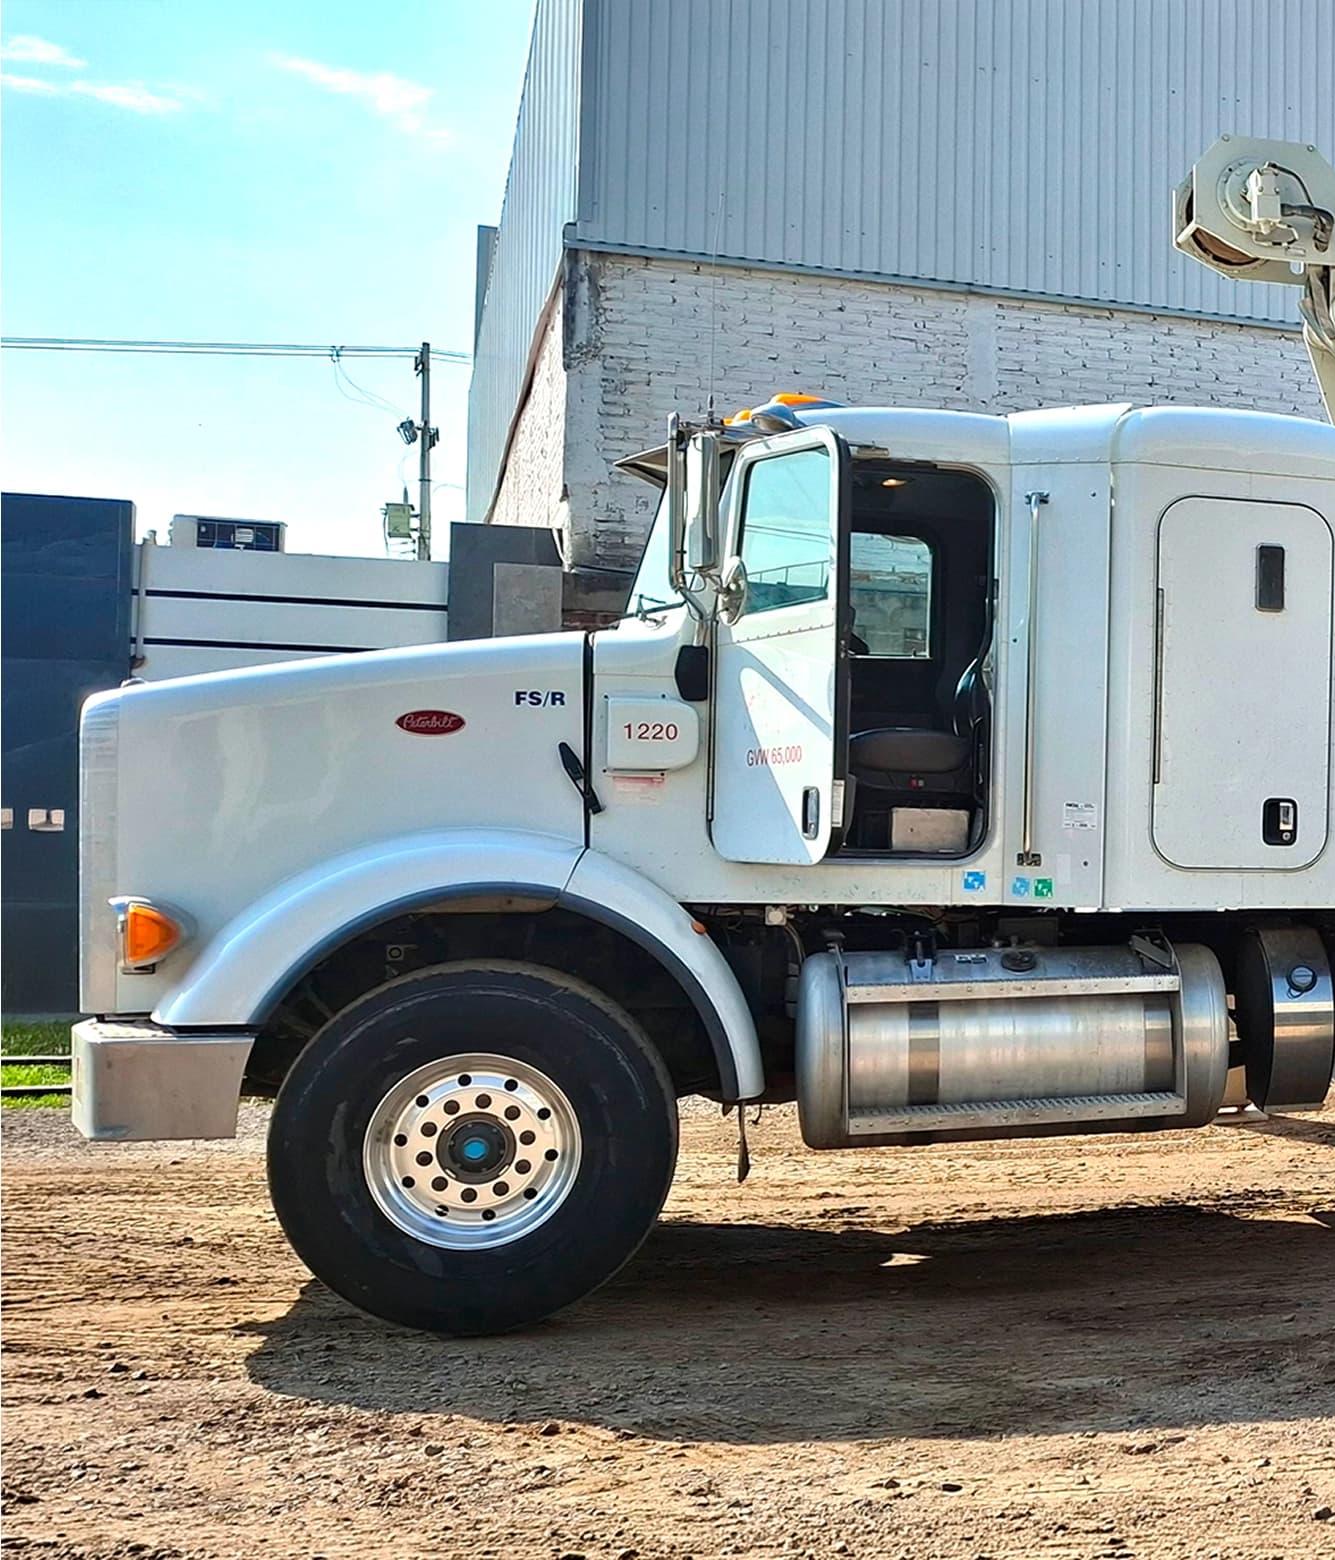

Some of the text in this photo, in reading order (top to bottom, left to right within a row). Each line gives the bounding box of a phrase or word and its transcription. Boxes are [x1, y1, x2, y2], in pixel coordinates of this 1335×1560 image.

[515, 691, 566, 707] FS/R
[623, 723, 679, 740] 1220
[746, 746, 803, 767] GVW 65,000
